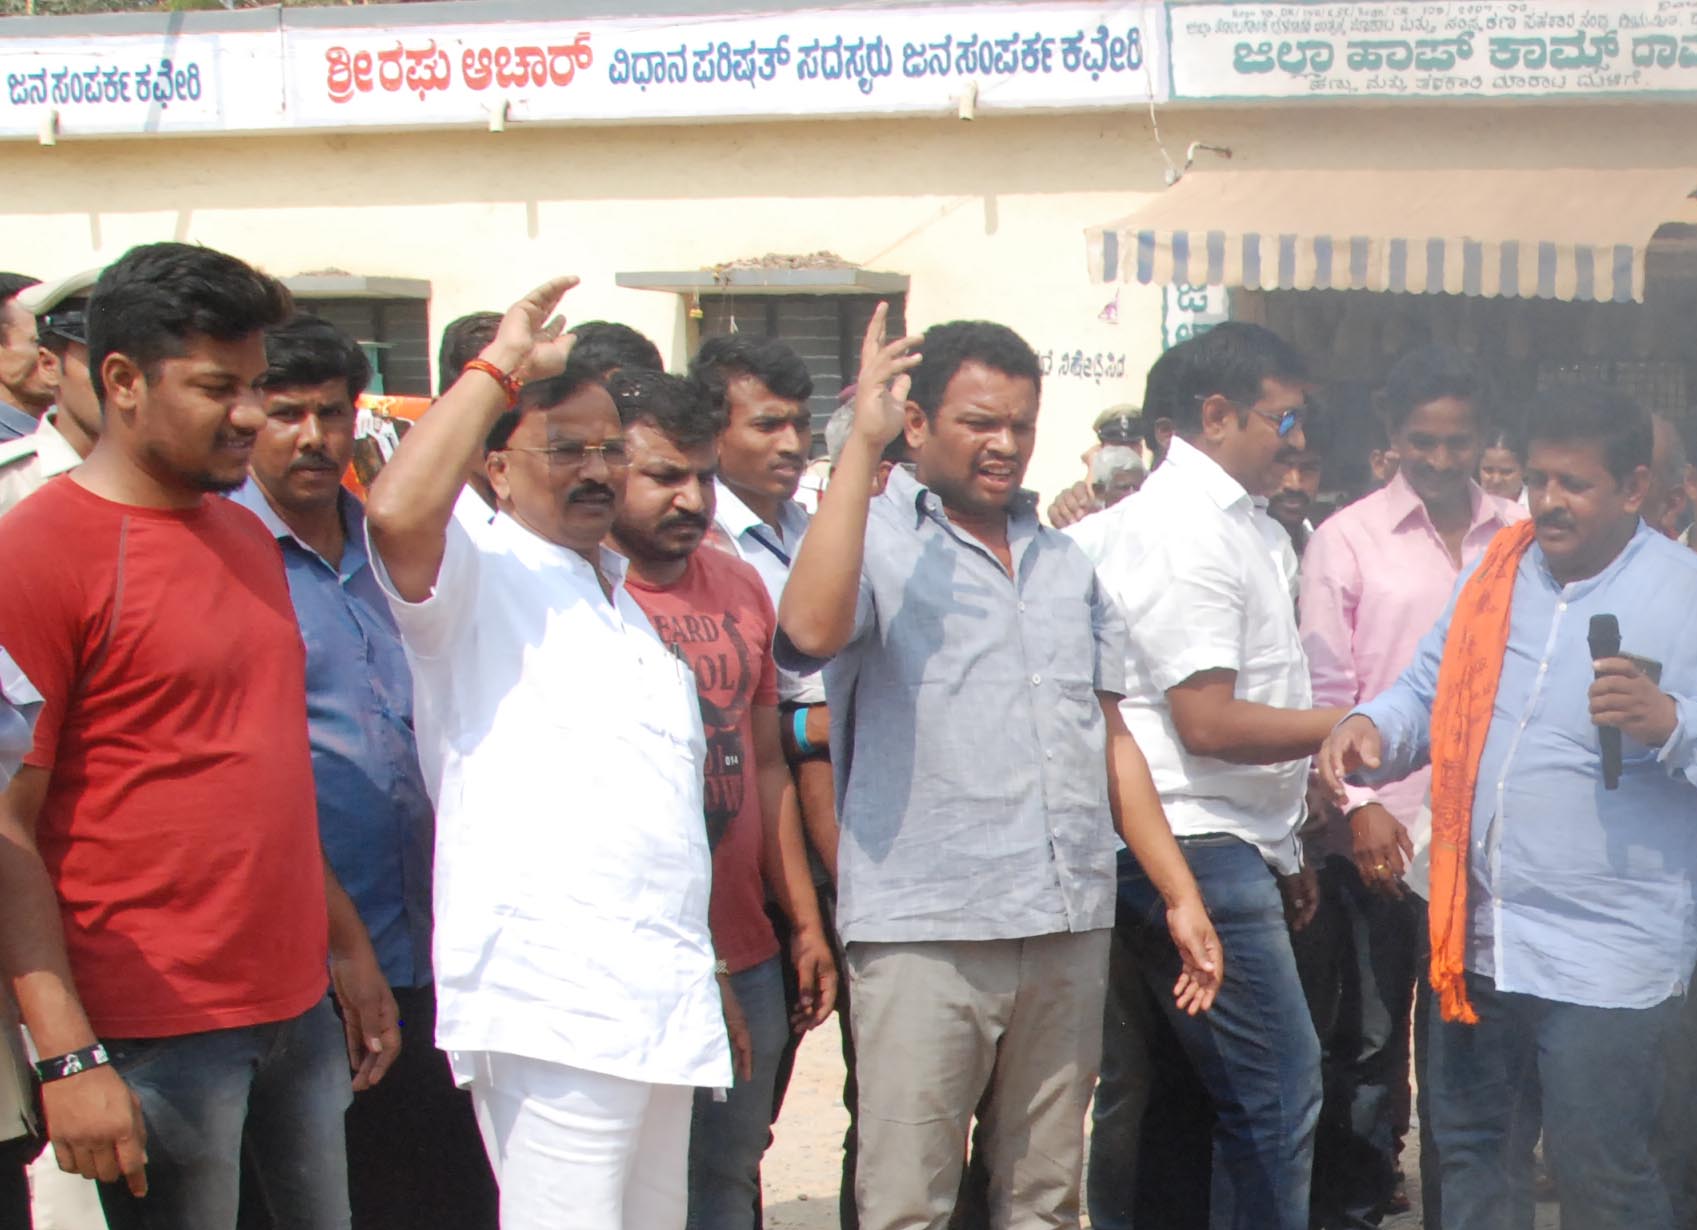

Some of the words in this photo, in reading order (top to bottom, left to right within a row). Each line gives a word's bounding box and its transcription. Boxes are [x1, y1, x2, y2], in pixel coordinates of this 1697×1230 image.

[461, 31, 593, 91] ಆಚಾರ್
[797, 34, 893, 95] ಸದಸ್ಯರು
[655, 614, 720, 645] EARD
